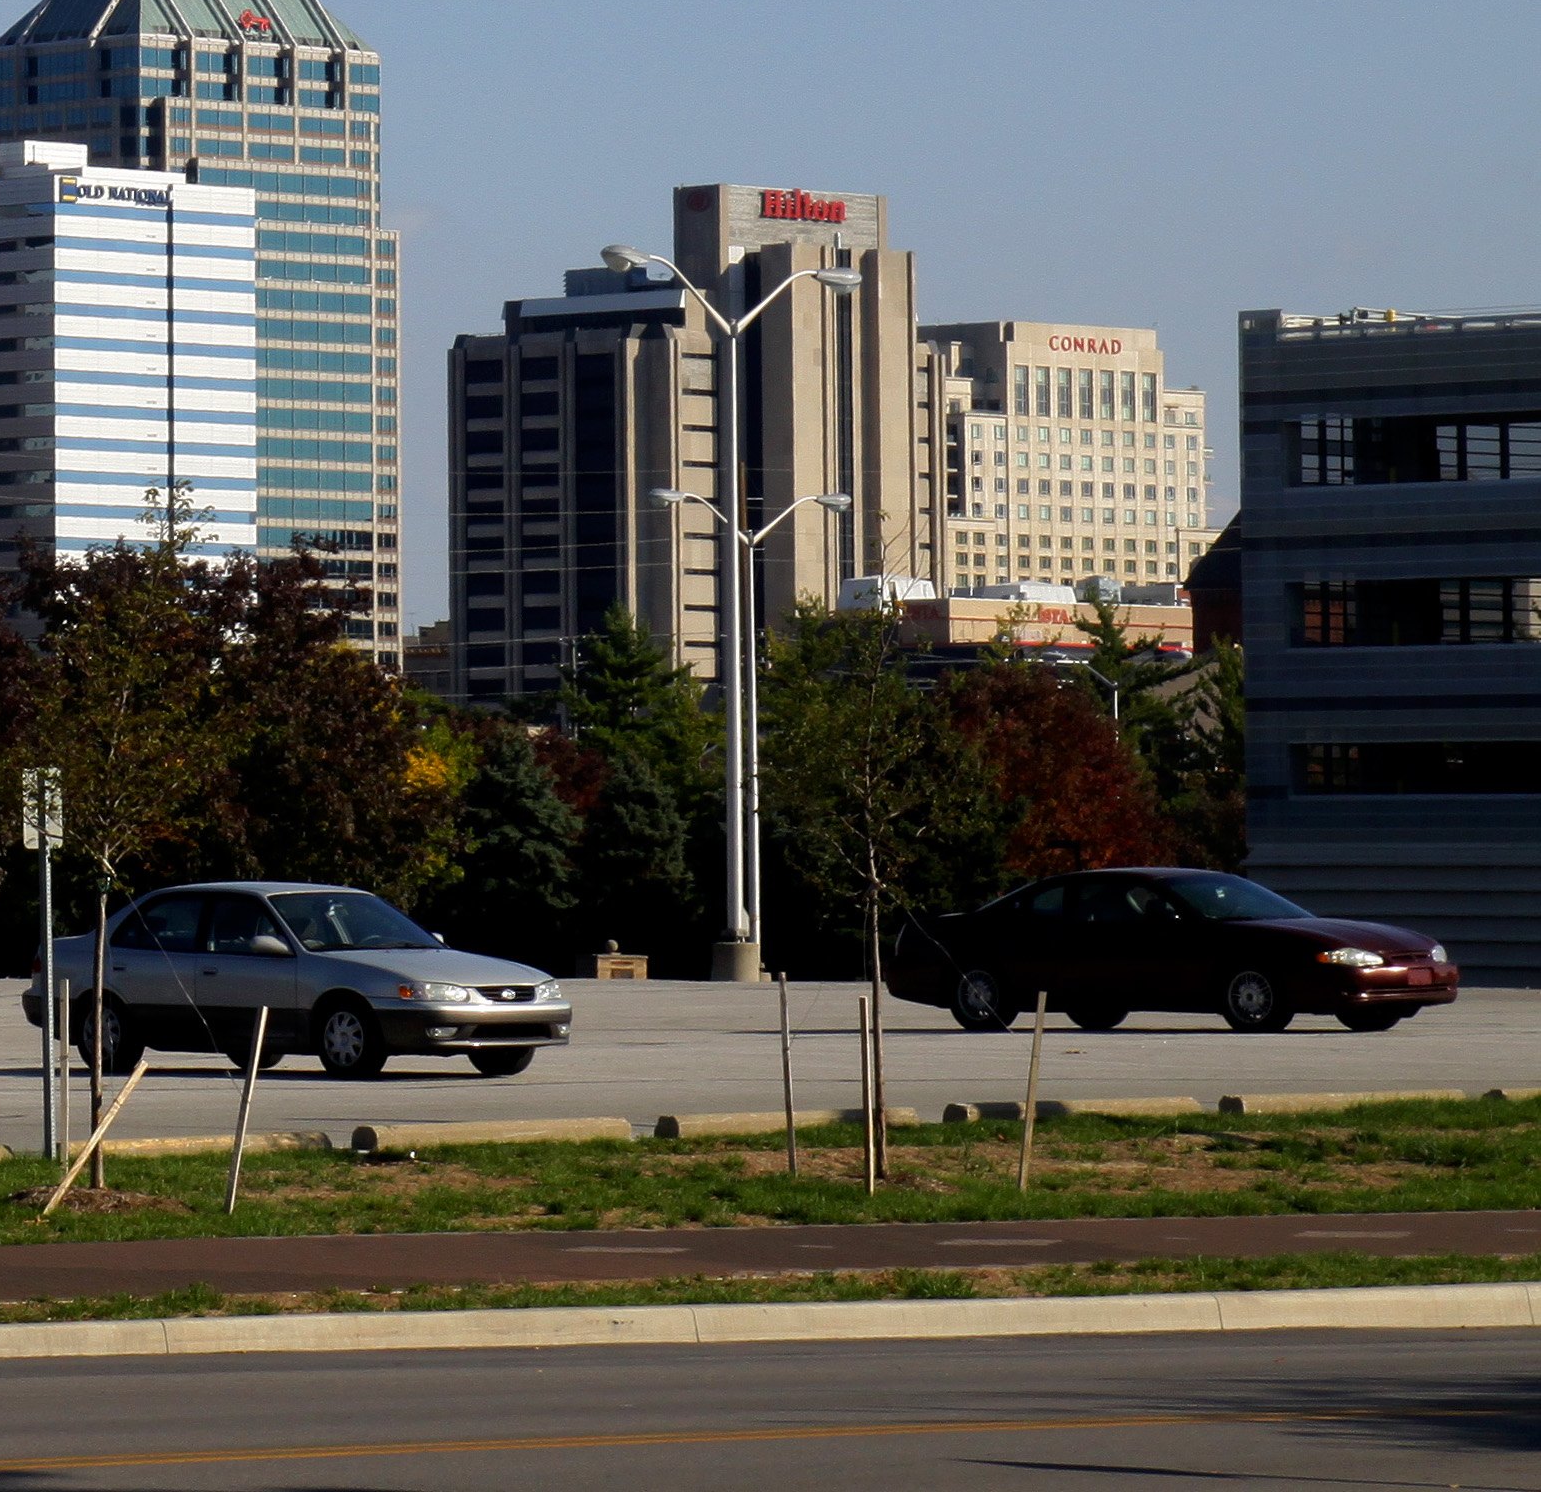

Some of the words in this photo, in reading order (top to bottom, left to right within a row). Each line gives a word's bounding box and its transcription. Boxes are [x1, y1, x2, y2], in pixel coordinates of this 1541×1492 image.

[78, 184, 105, 200] OLD
[107, 186, 173, 205] NATIONAL
[763, 188, 847, 222] Hilton
[1048, 335, 1122, 355] CONRAD
